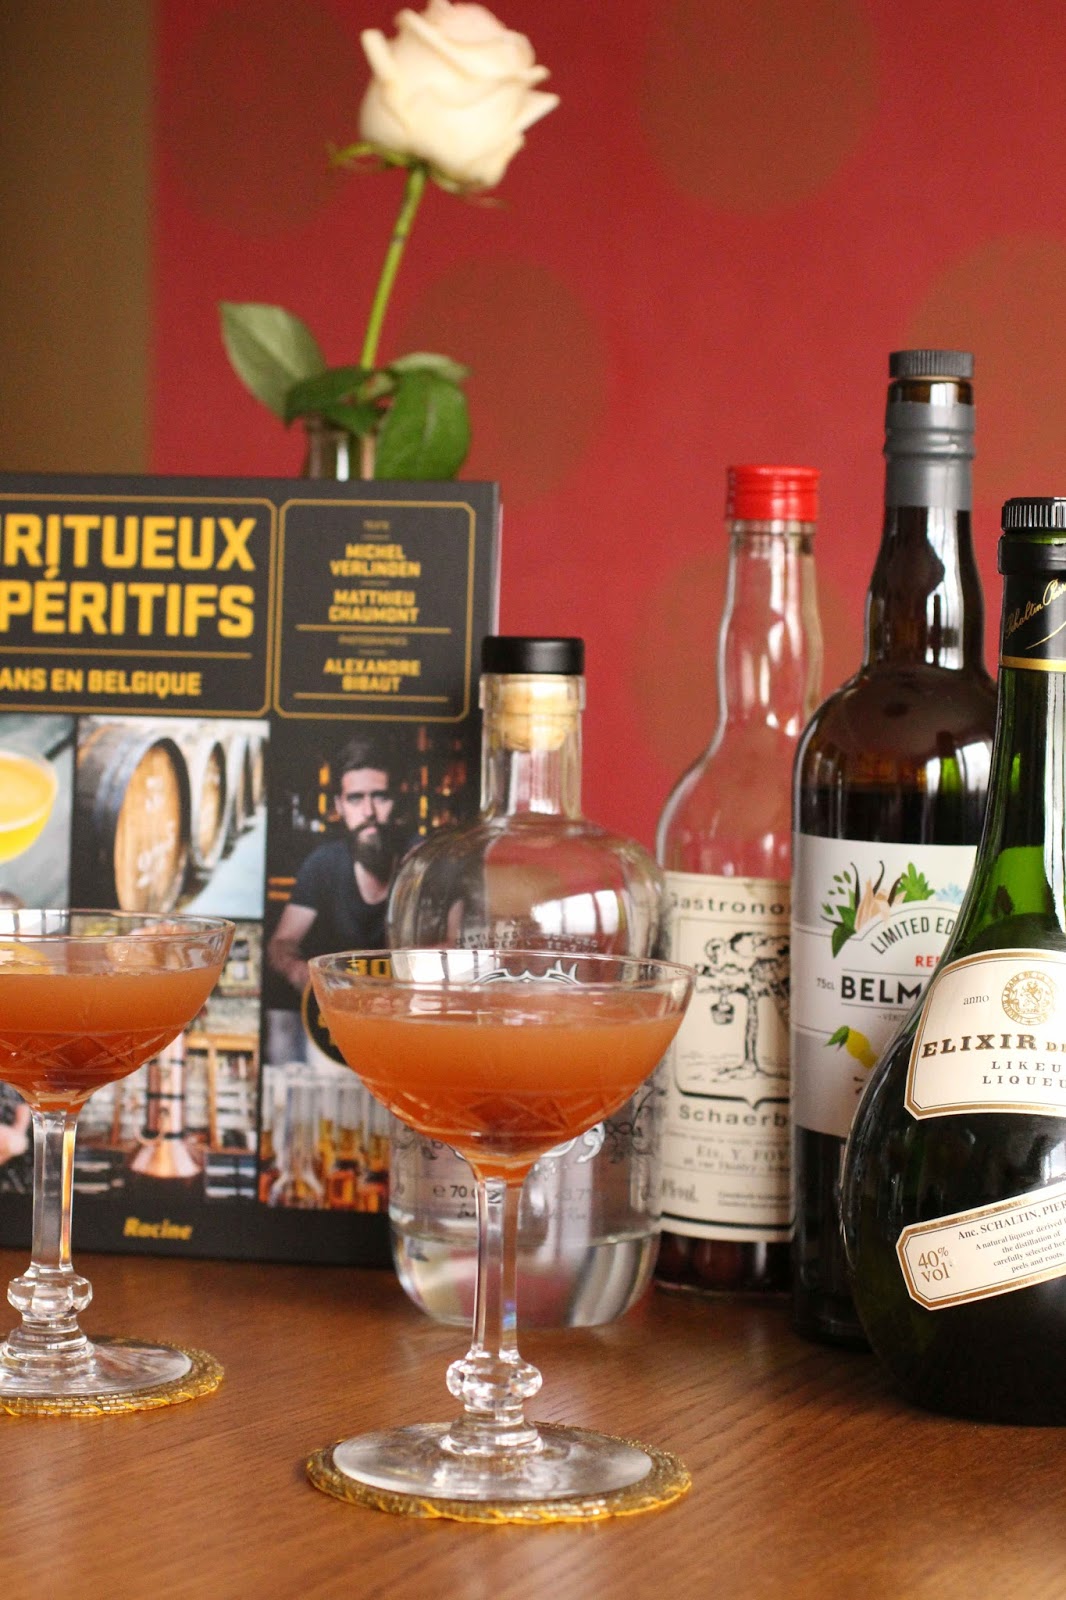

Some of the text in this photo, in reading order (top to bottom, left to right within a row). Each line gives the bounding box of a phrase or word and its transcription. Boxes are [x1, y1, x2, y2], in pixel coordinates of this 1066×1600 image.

[0, 513, 257, 571] RITUEUX
[51, 669, 83, 692] EN
[88, 670, 202, 699] BELGIQUE
[871, 916, 930, 955] LIMITED
[841, 975, 922, 1004] BELM
[963, 994, 989, 1006] anno
[921, 1033, 1038, 1059] ELIXIR
[449, 1185, 467, 1198] 70
[123, 1217, 192, 1240] Racine
[958, 1229, 979, 1240] Anc.
[980, 1209, 1041, 1234] SCHALTIN,
[982, 1236, 1008, 1248] natural
[1008, 1228, 1034, 1241] liqueur
[1036, 1218, 1063, 1233] derived
[993, 1238, 1066, 1267] carefully selected her
[1002, 1230, 1061, 1254] the distillation of
[918, 1246, 949, 1269] 40%
[1011, 1262, 1029, 1274] peels
[1030, 1256, 1044, 1267] and
